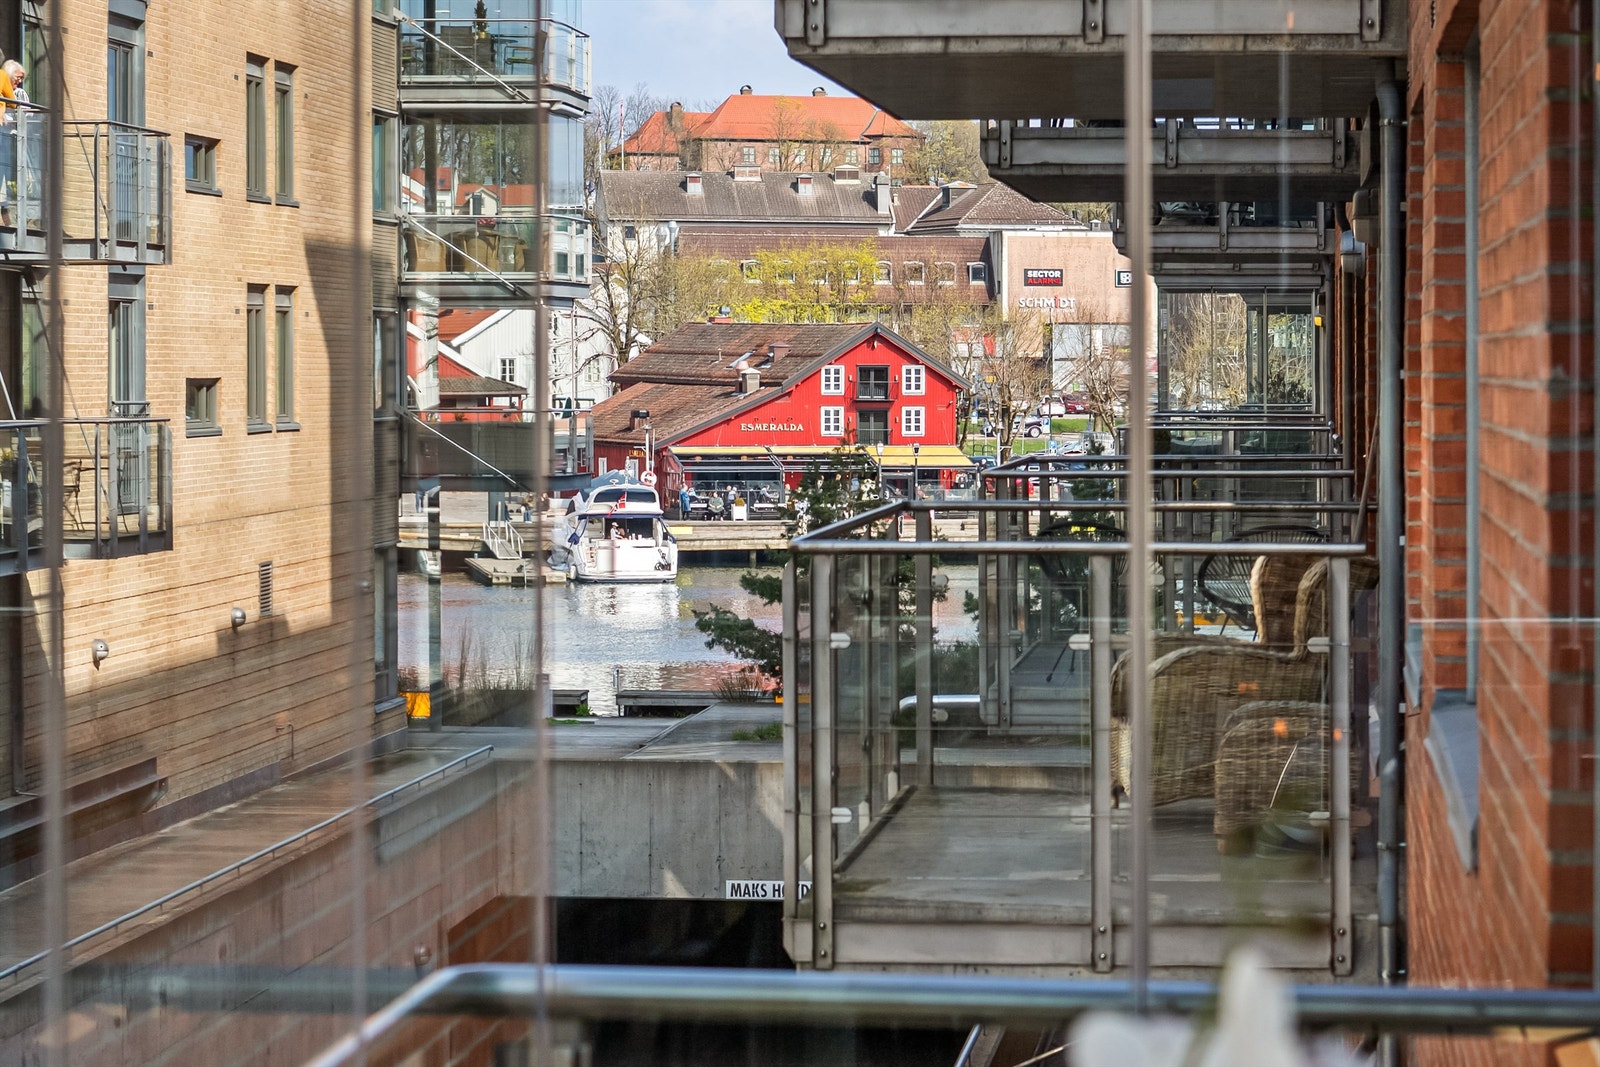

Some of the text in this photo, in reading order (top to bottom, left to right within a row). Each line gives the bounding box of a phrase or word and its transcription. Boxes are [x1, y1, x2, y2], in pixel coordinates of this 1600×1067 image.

[1027, 270, 1061, 278] SECTOR
[741, 423, 804, 431] ESMERALDA
[730, 883, 768, 898] MAKS
